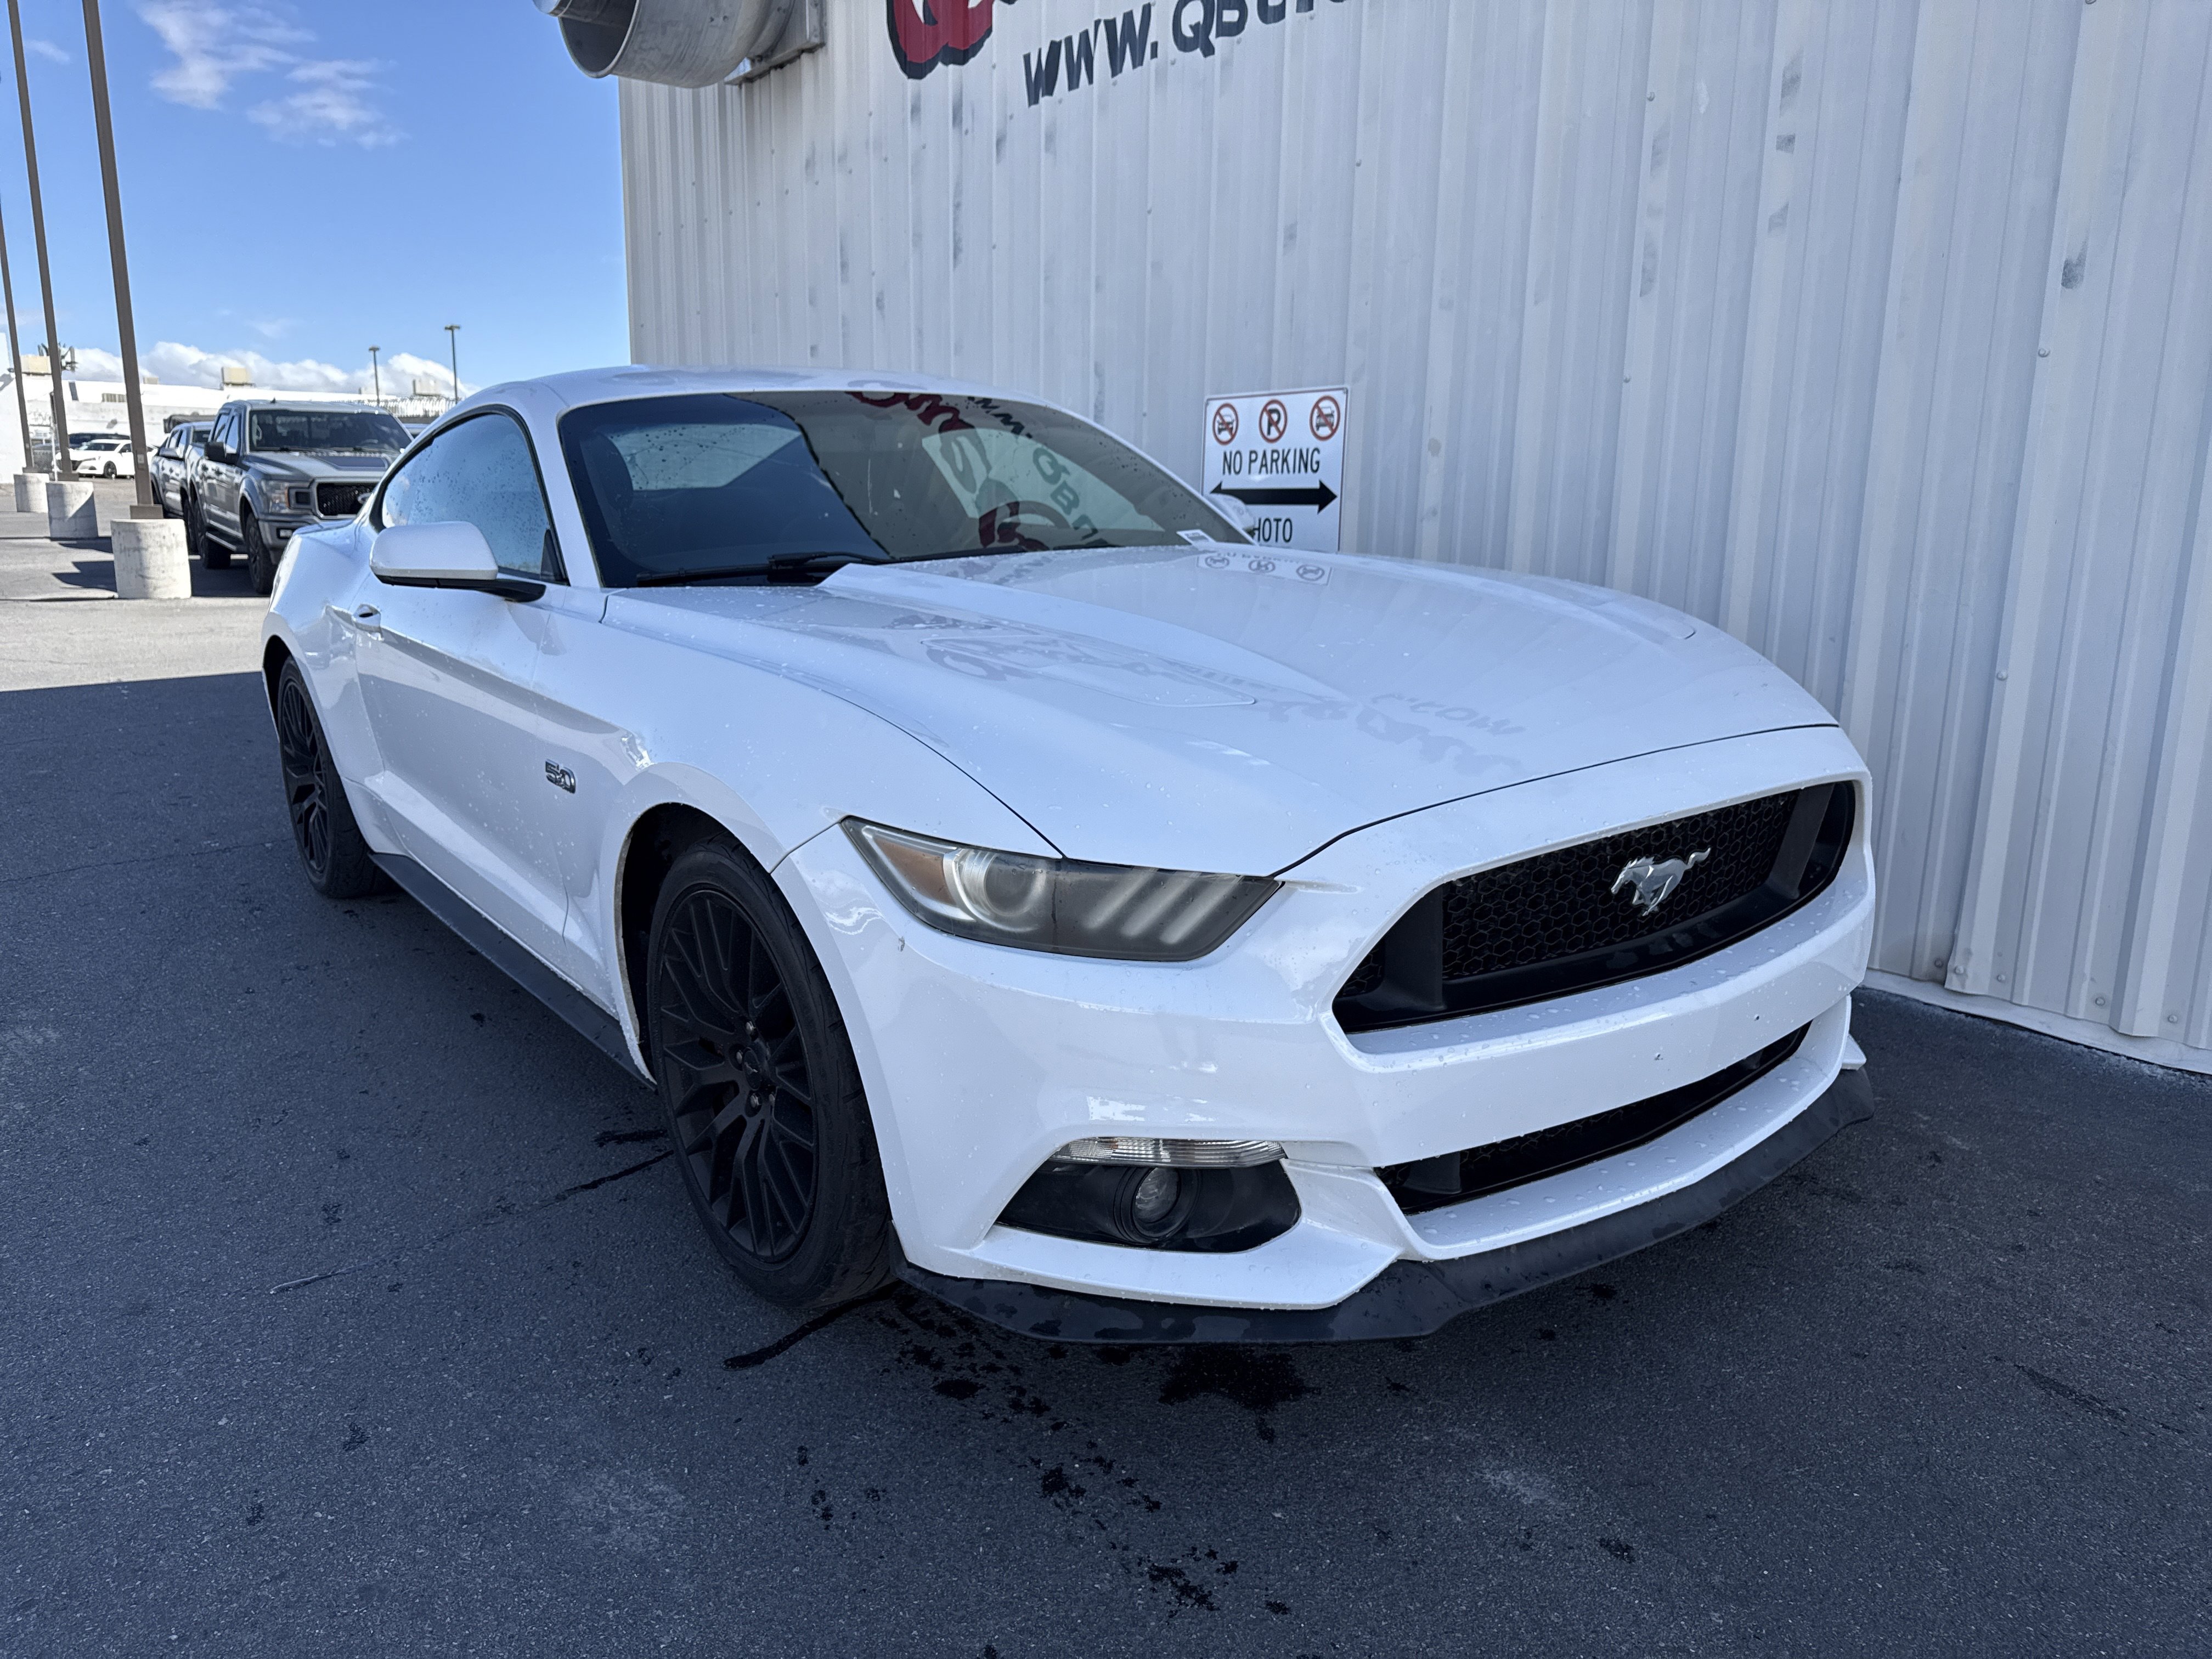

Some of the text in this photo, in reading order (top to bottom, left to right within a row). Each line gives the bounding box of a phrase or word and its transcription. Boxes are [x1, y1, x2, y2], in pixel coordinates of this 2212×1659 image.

[1222, 448, 1321, 475] NO PARKING
[1253, 518, 1293, 543] HOTO
